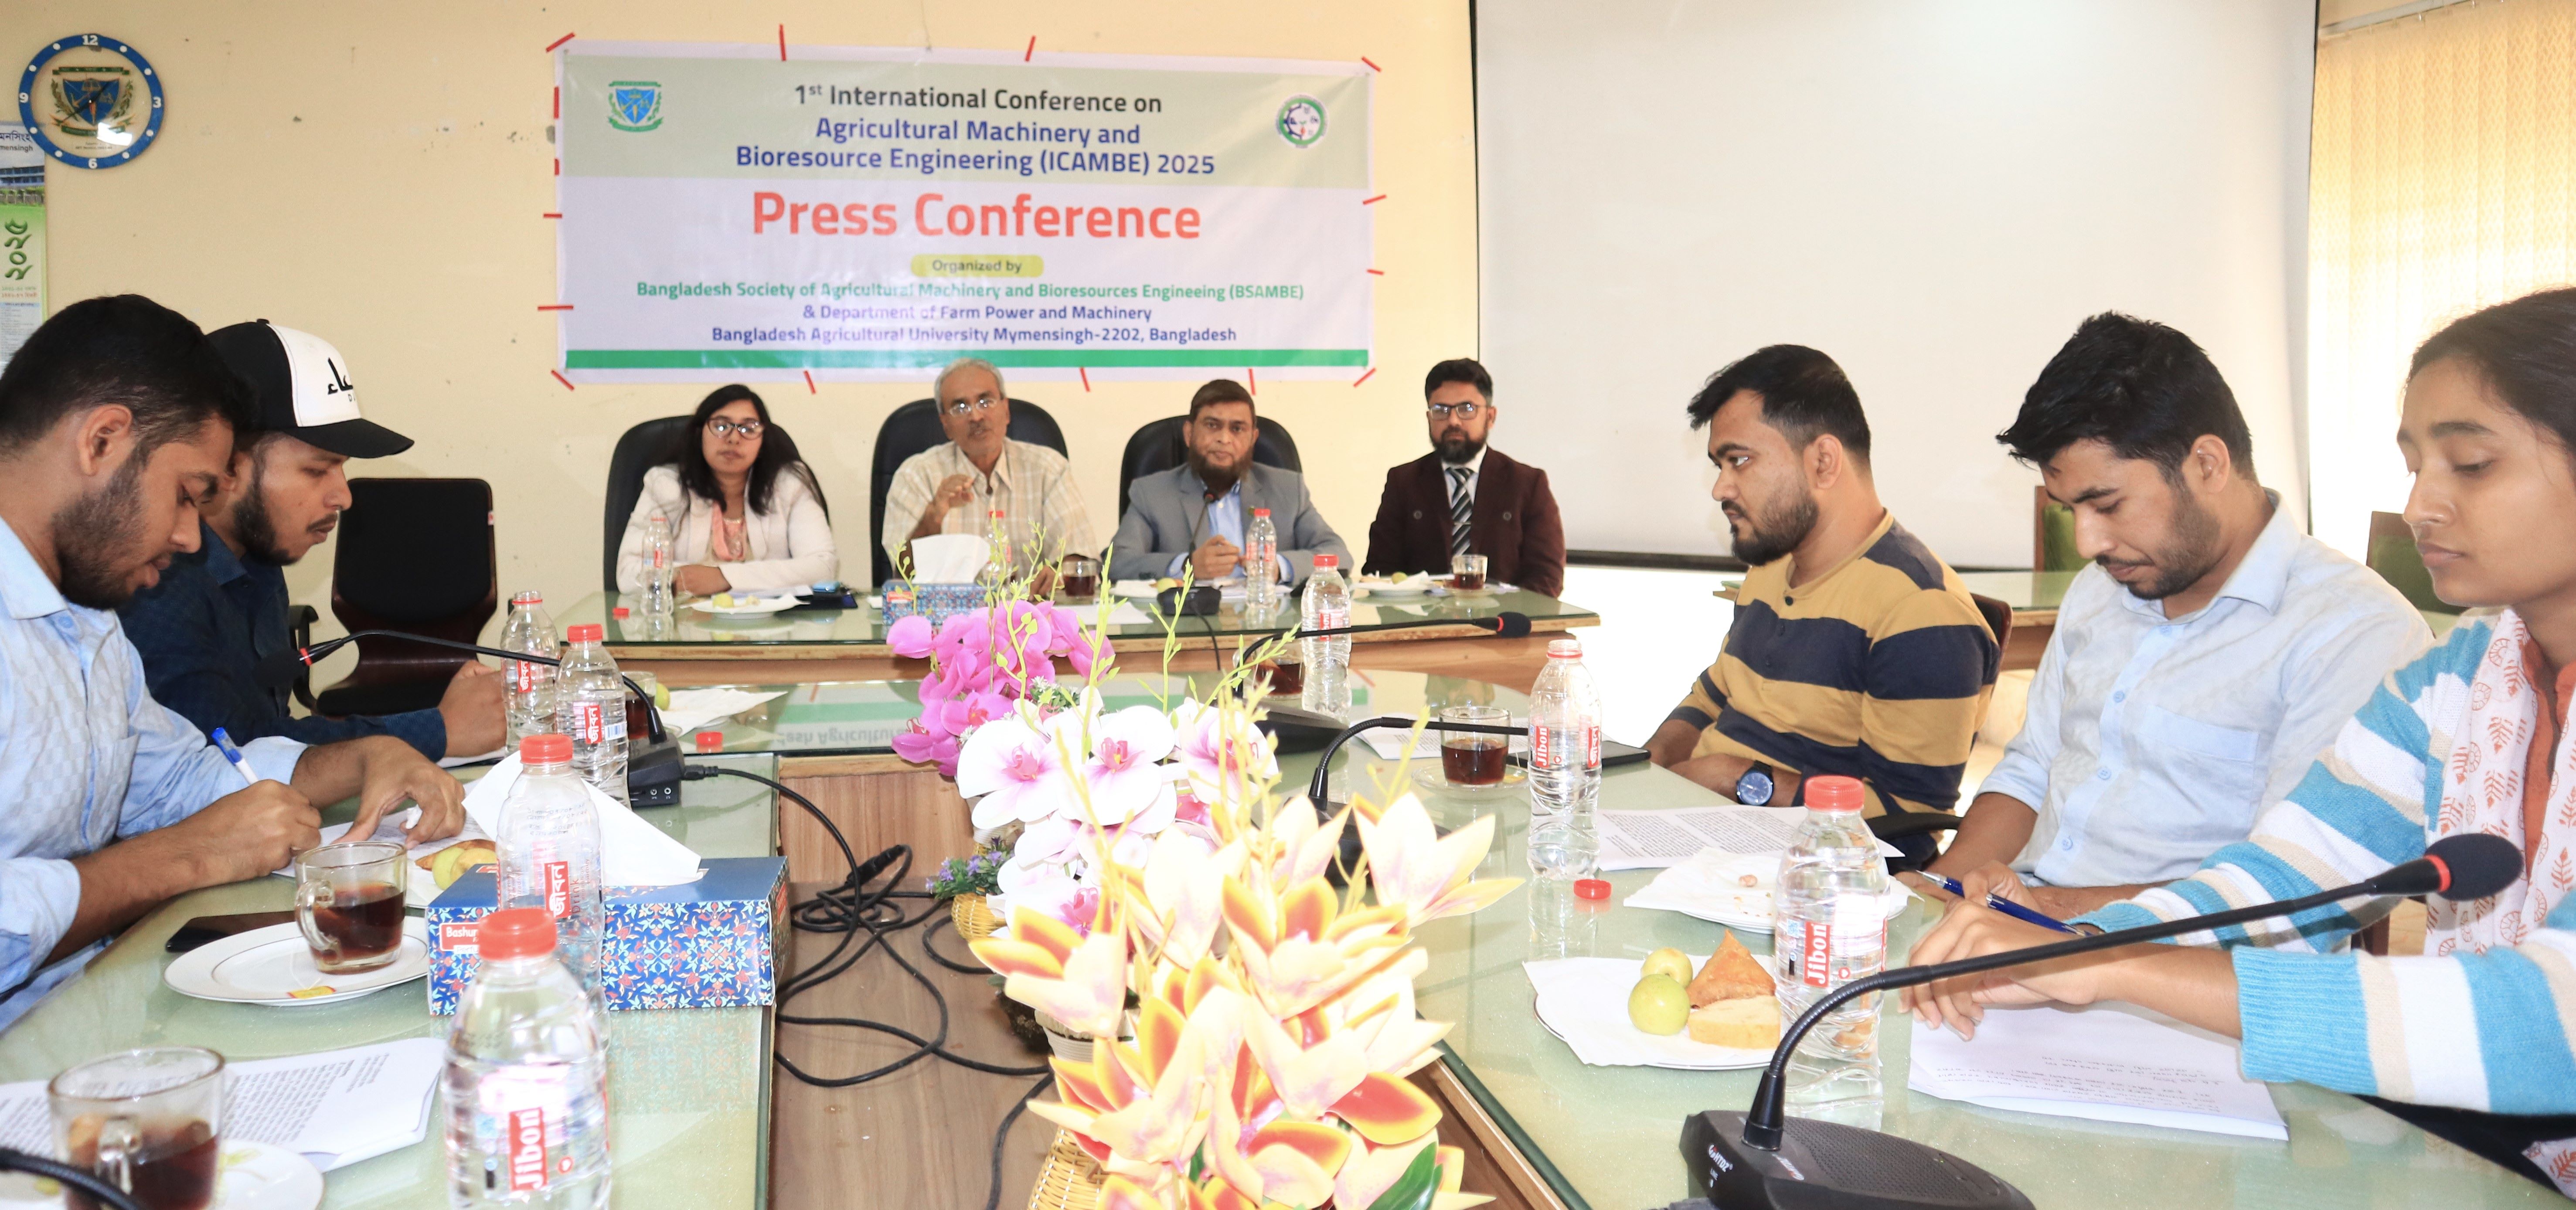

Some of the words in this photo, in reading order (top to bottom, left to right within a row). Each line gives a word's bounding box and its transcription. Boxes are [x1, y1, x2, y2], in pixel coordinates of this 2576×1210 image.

[82, 34, 98, 46] 12
[19, 93, 29, 103] 9
[153, 97, 162, 109] 3
[830, 85, 987, 108] International
[994, 88, 1127, 112] Conference
[1133, 97, 1162, 112] on
[816, 117, 958, 143] Agricultural
[966, 120, 1091, 148] Machinery
[1098, 124, 1140, 144] and
[88, 158, 97, 169] 6
[736, 146, 882, 168] Bioresource
[890, 148, 1033, 175] Engineering
[1040, 150, 1150, 176] (ICAMBE)
[1157, 154, 1215, 174] 2025
[753, 191, 897, 236] Press
[915, 192, 1201, 240] Conference
[4, 218, 33, 280] ২০২৫
[932, 260, 1001, 273] Organized
[1006, 260, 1021, 273] by
[637, 281, 732, 300] Bangladesh
[736, 282, 795, 299] Society
[799, 282, 816, 296] of
[820, 282, 914, 300] Agricultural
[919, 283, 1001, 300] Machinery
[1005, 283, 1034, 298] and
[1038, 283, 1138, 298] Bioresources
[1142, 284, 1225, 302] Engineeing
[1229, 284, 1304, 301] (BSAMBE)
[803, 305, 815, 318] &
[820, 305, 915, 321] Department
[920, 306, 936, 319] of
[940, 306, 980, 319] Farm
[985, 306, 1034, 319] Power
[1038, 305, 1067, 319] and
[1072, 305, 1152, 322] Machinery
[712, 327, 805, 345] Bangladesh
[811, 328, 904, 344] Agricultural
[909, 327, 989, 344] University
[994, 327, 1144, 344] Mymensingh-2202,
[1150, 327, 1236, 344] Bangladesh
[587, 707, 599, 744] জীবন
[1537, 727, 1547, 766] Jibon
[548, 864, 566, 918] জীবন
[571, 878, 581, 914] Drink
[1807, 924, 1827, 985] Jibon
[514, 1110, 544, 1190] Jibon
